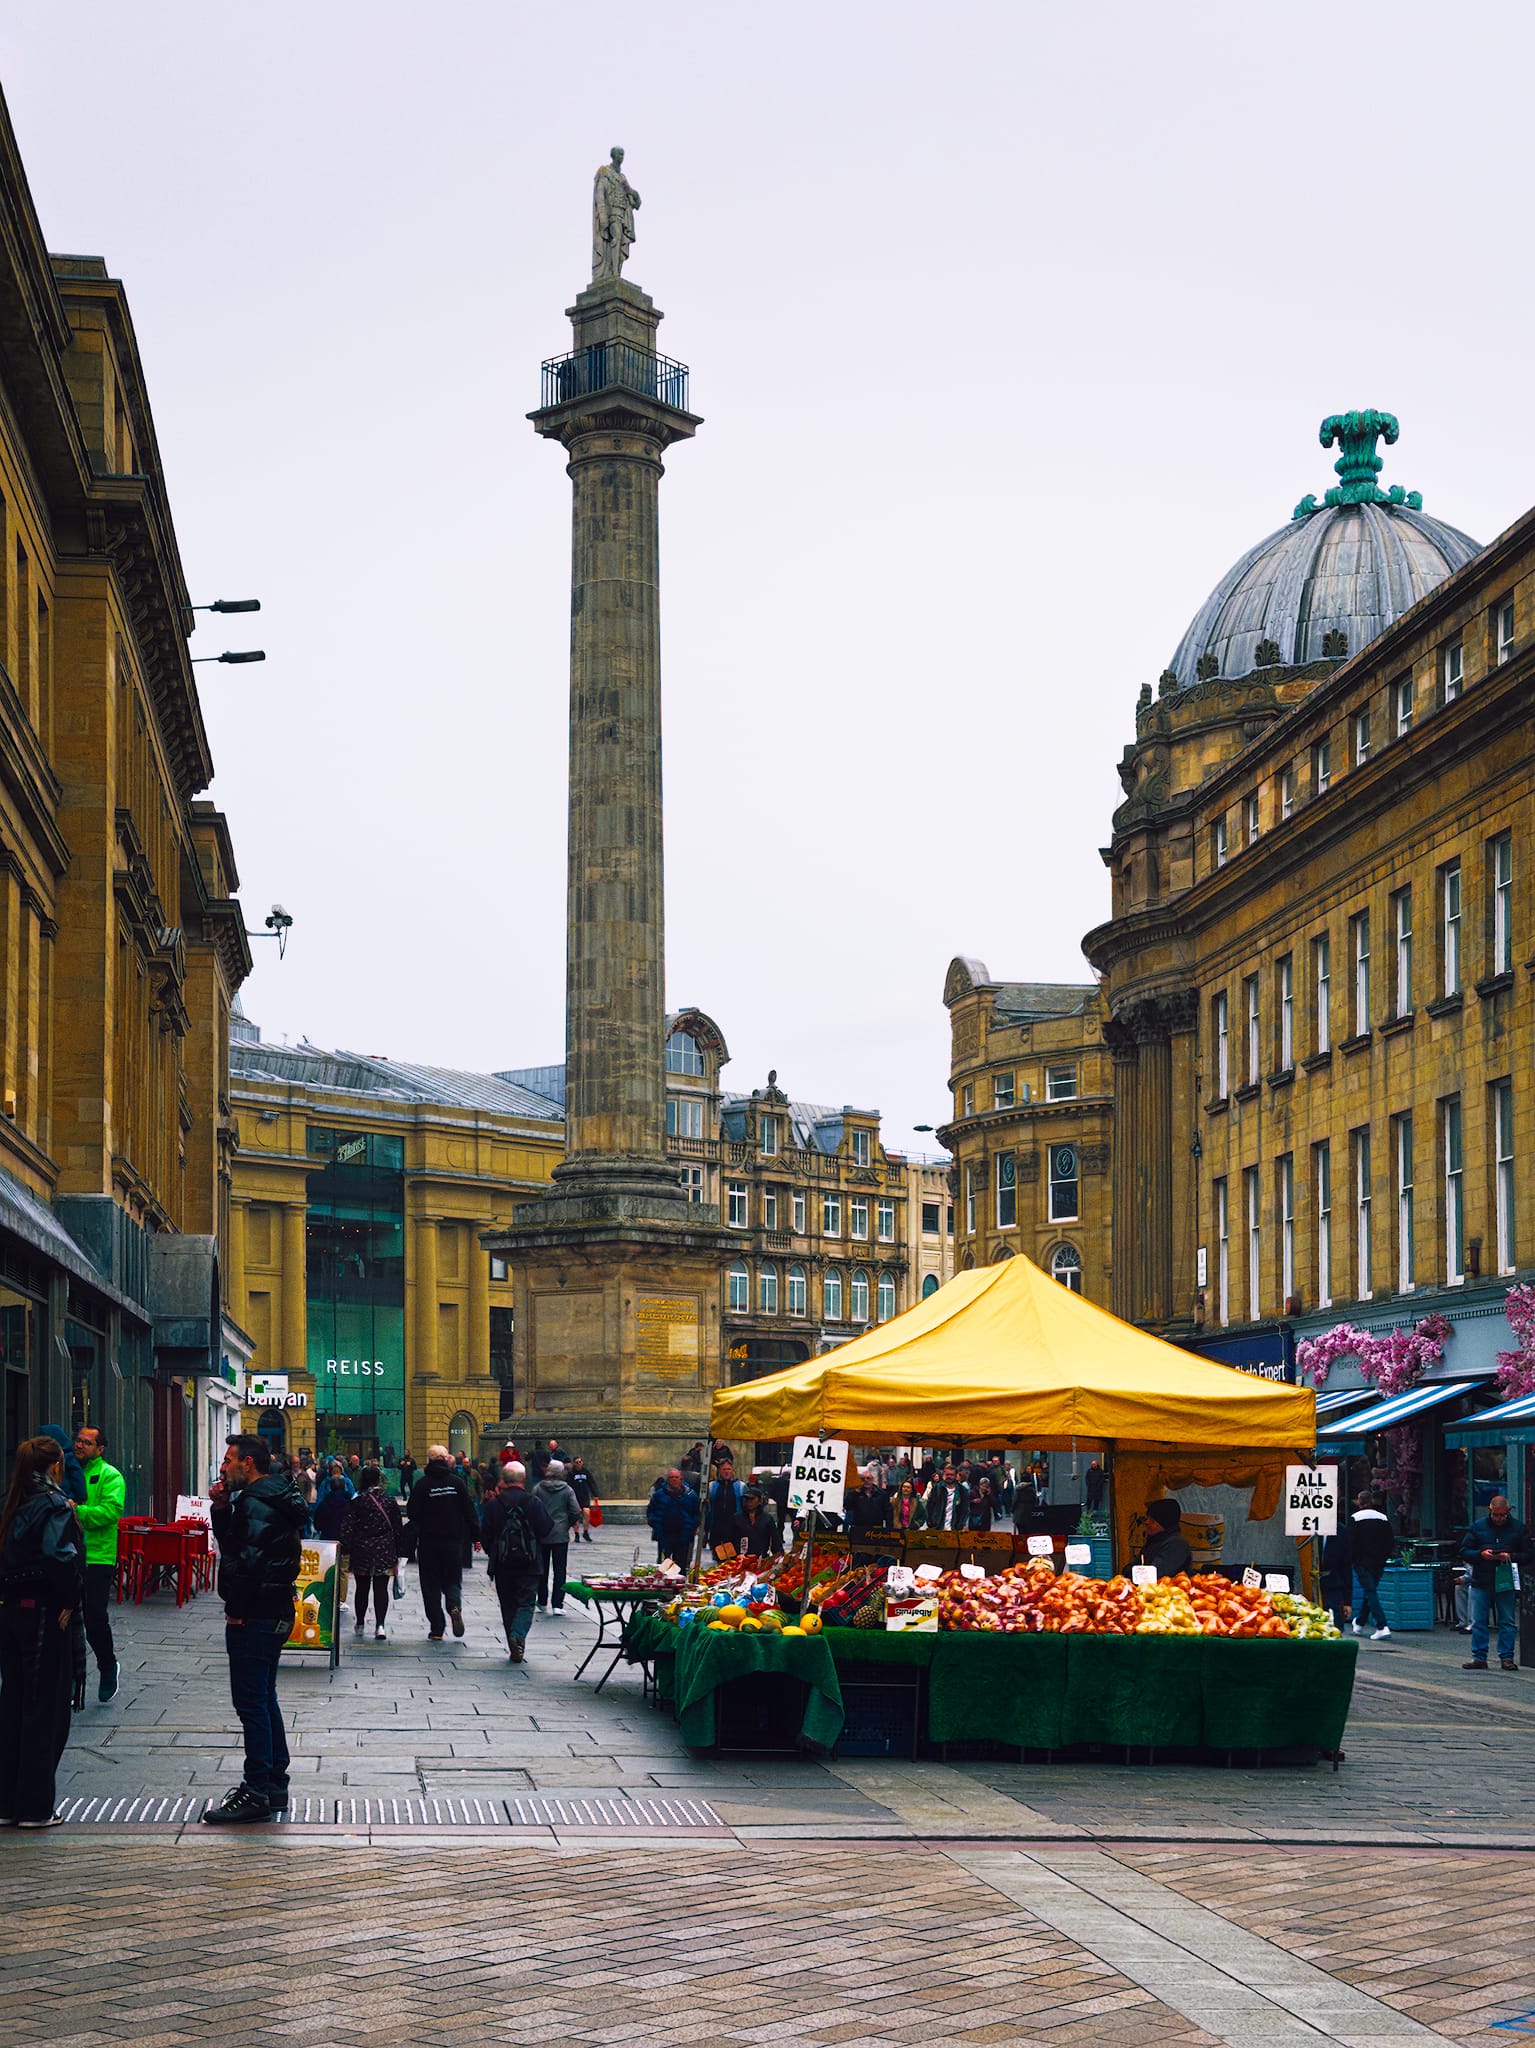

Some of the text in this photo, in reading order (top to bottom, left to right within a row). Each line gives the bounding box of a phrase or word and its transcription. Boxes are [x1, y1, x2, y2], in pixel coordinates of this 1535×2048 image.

[326, 1359, 384, 1375] REISS
[247, 1387, 307, 1410] banyan
[804, 1444, 836, 1460] ALL
[795, 1466, 841, 1483] BAGS
[1296, 1472, 1327, 1487] ALL
[806, 1489, 825, 1504] £1
[1290, 1494, 1334, 1509] BAGS
[1302, 1516, 1319, 1530] £1
